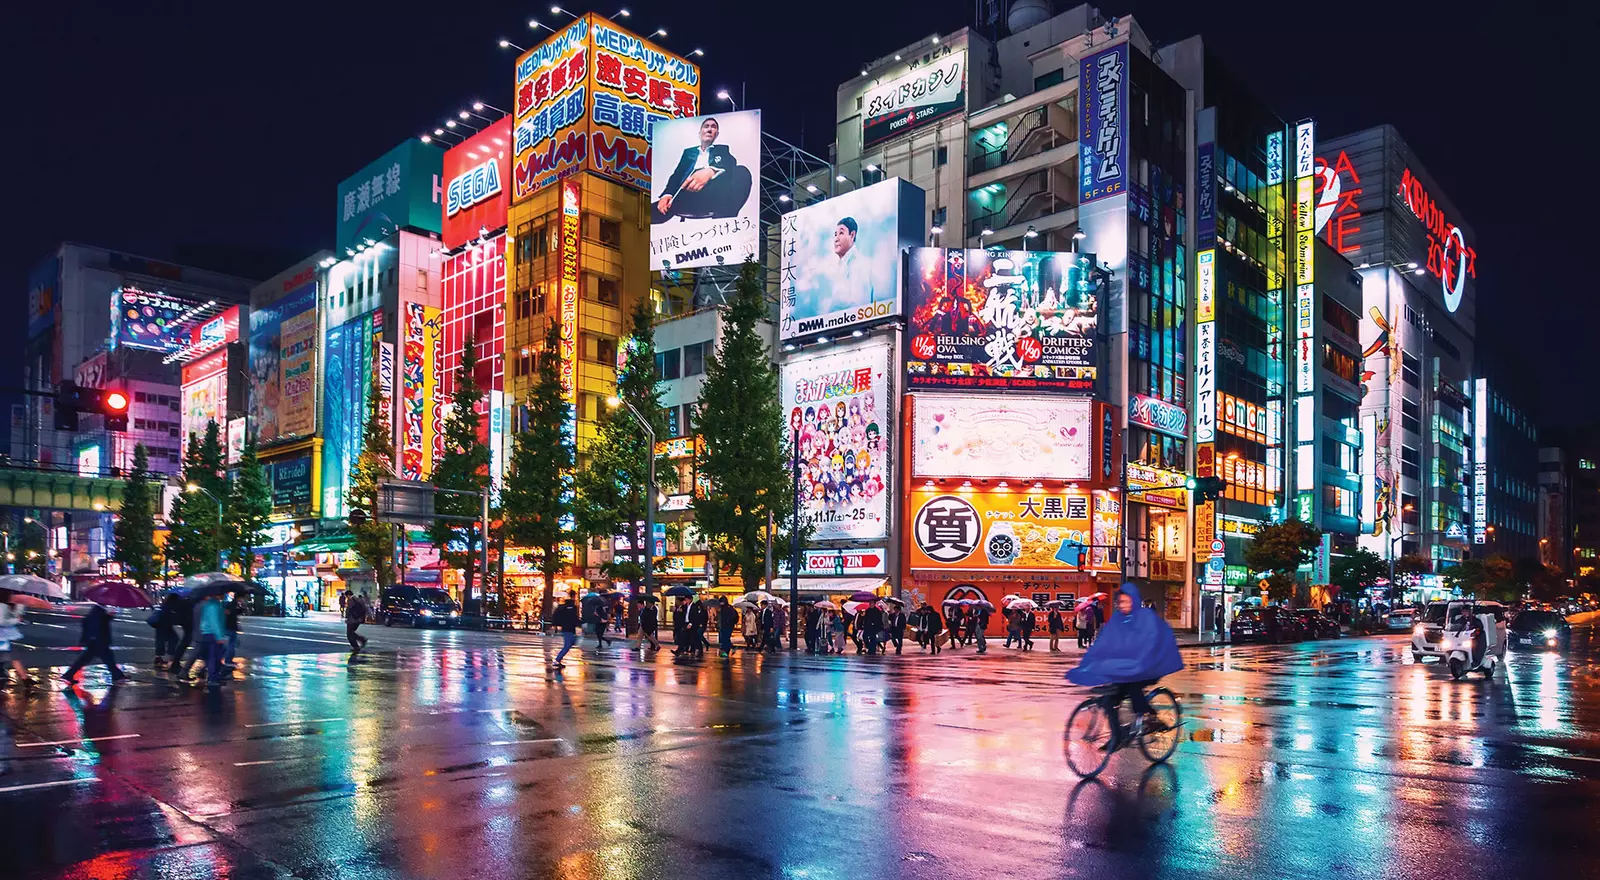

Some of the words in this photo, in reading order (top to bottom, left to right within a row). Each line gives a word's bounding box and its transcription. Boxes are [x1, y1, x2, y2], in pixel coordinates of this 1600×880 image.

[517, 50, 587, 117] 激安販売
[595, 53, 696, 117] 激安販売
[868, 64, 959, 117] メイドカジノ
[516, 87, 585, 154] 高額買取
[889, 117, 908, 131] POKER
[916, 106, 934, 120] STARS
[515, 131, 587, 196] Mulan
[343, 163, 401, 222] 廣瀬無線
[447, 161, 501, 216] SEGA
[1299, 200, 1308, 228] Yellow
[650, 216, 758, 256] 冒険しつづけよう。
[675, 244, 732, 265] DMM.com
[781, 213, 798, 339] 次は太陽か。
[1299, 235, 1309, 280] Submarine
[1427, 234, 1455, 293] ZONE
[798, 312, 857, 334] DMM.make
[857, 300, 894, 320] solar
[937, 336, 985, 346] HELLSING
[937, 345, 957, 354] OVA
[1042, 347, 1080, 355] COMICS
[1043, 337, 1093, 348] DRIFTERS
[1199, 364, 1212, 425] ルノアール
[986, 510, 1015, 519] チケット
[1020, 497, 1087, 519] 大黒屋
[919, 506, 972, 554] 質
[810, 556, 840, 568] COM
[846, 555, 863, 567] ZIN
[1023, 582, 1059, 593] チケット
